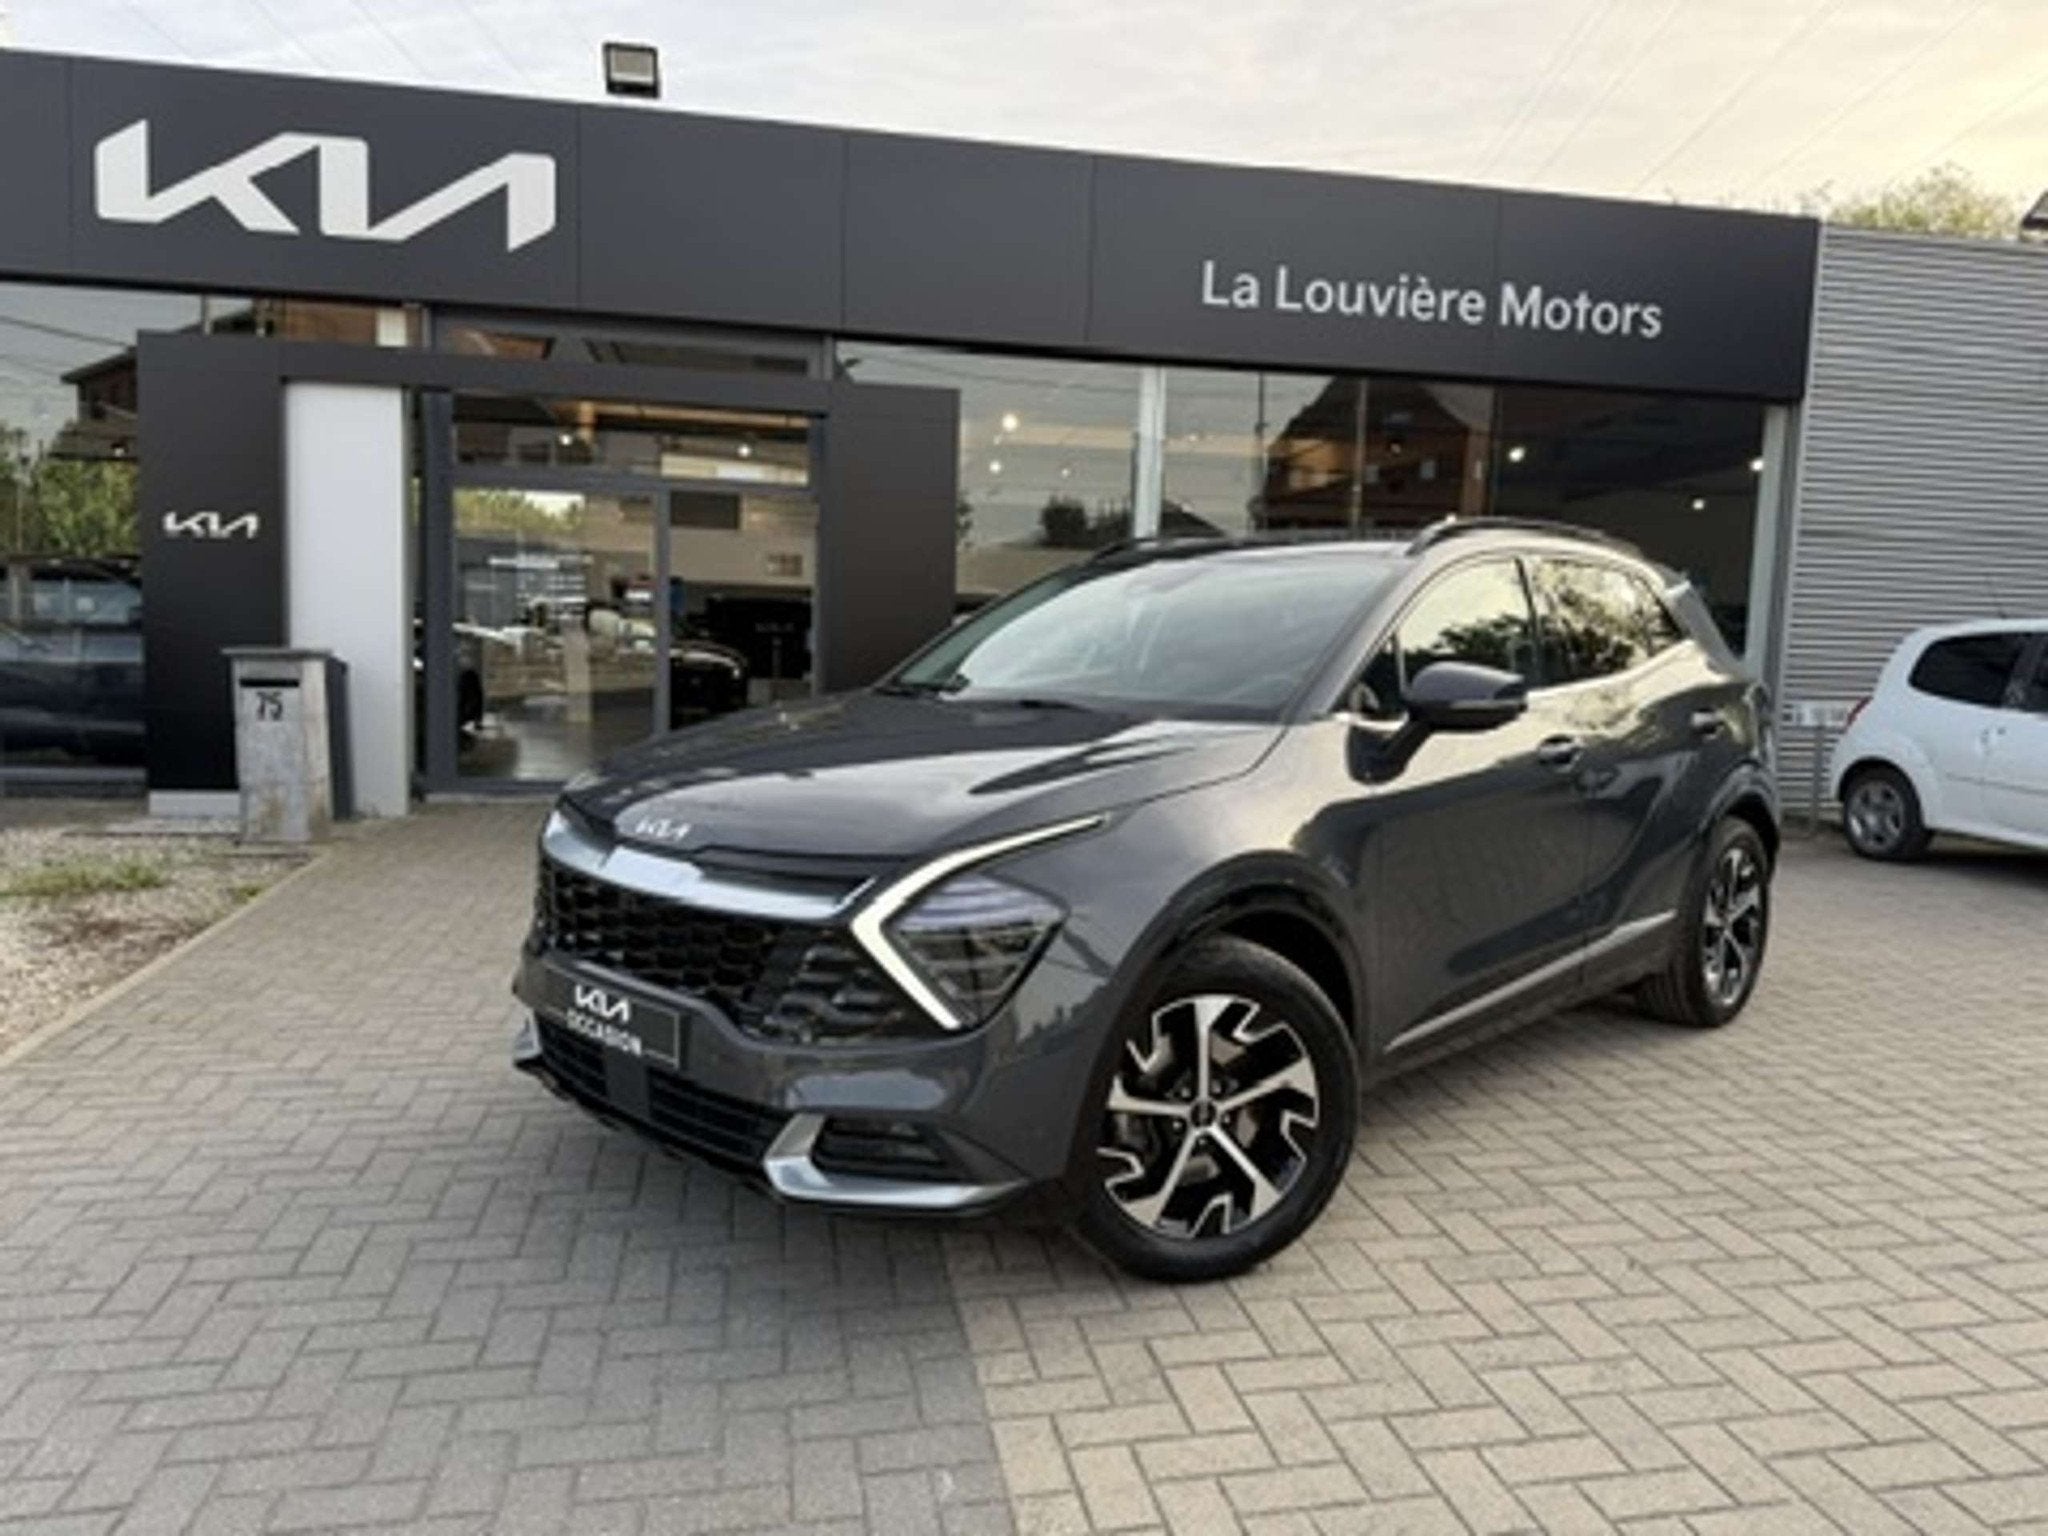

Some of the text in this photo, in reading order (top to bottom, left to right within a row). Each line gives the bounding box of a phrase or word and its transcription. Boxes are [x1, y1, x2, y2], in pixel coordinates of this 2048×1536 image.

[94, 118, 557, 253] KIA
[1201, 259, 1663, 339] La Louvière Motors
[162, 510, 260, 540] KIA
[255, 690, 284, 722] 75
[575, 983, 630, 1022] KIA
